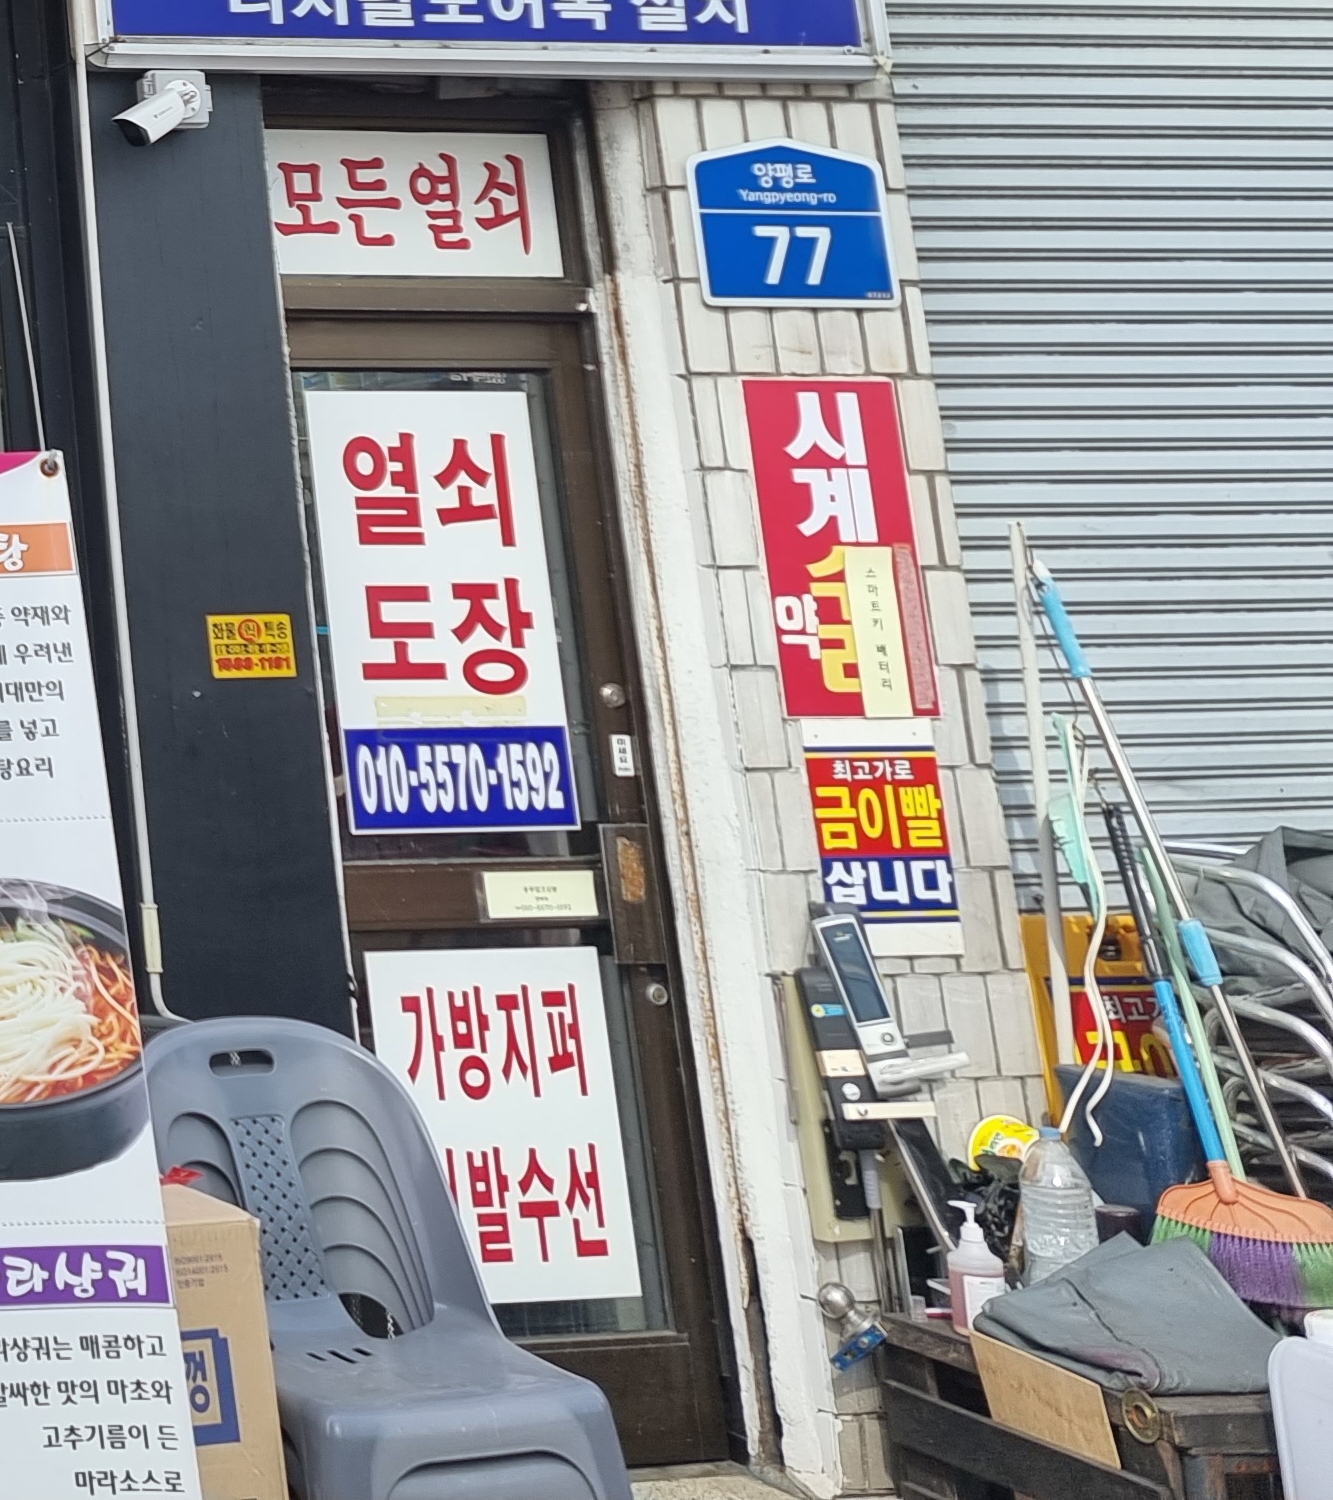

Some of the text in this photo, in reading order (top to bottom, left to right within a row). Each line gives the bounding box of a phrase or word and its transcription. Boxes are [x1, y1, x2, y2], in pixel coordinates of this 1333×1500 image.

[736, 187, 837, 206] Yangpyeong-ro
[751, 161, 816, 187] 양평로
[273, 151, 534, 256] 모든열쇠
[752, 226, 834, 286] 77
[342, 432, 518, 548] 열쇠
[785, 391, 879, 543] 시계
[10, 604, 72, 627] 약재와
[362, 577, 535, 696] 도장
[775, 594, 822, 660] 약
[13, 642, 74, 664] 우려낸
[20, 717, 60, 741] 넣고
[355, 741, 566, 815] 010-5570-1592
[832, 758, 914, 781] 최고가로
[815, 784, 943, 849] 금이빨
[824, 860, 953, 906] 삽니다
[400, 983, 590, 1101] 가방지퍼
[444, 1142, 611, 1264] 발수선
[79, 1334, 168, 1360] 매콤하고
[57, 1380, 100, 1405] 맛의
[106, 1379, 173, 1405] 마초와
[42, 1424, 179, 1451] 고추기름이 든
[74, 1470, 186, 1494] 마라소스로
